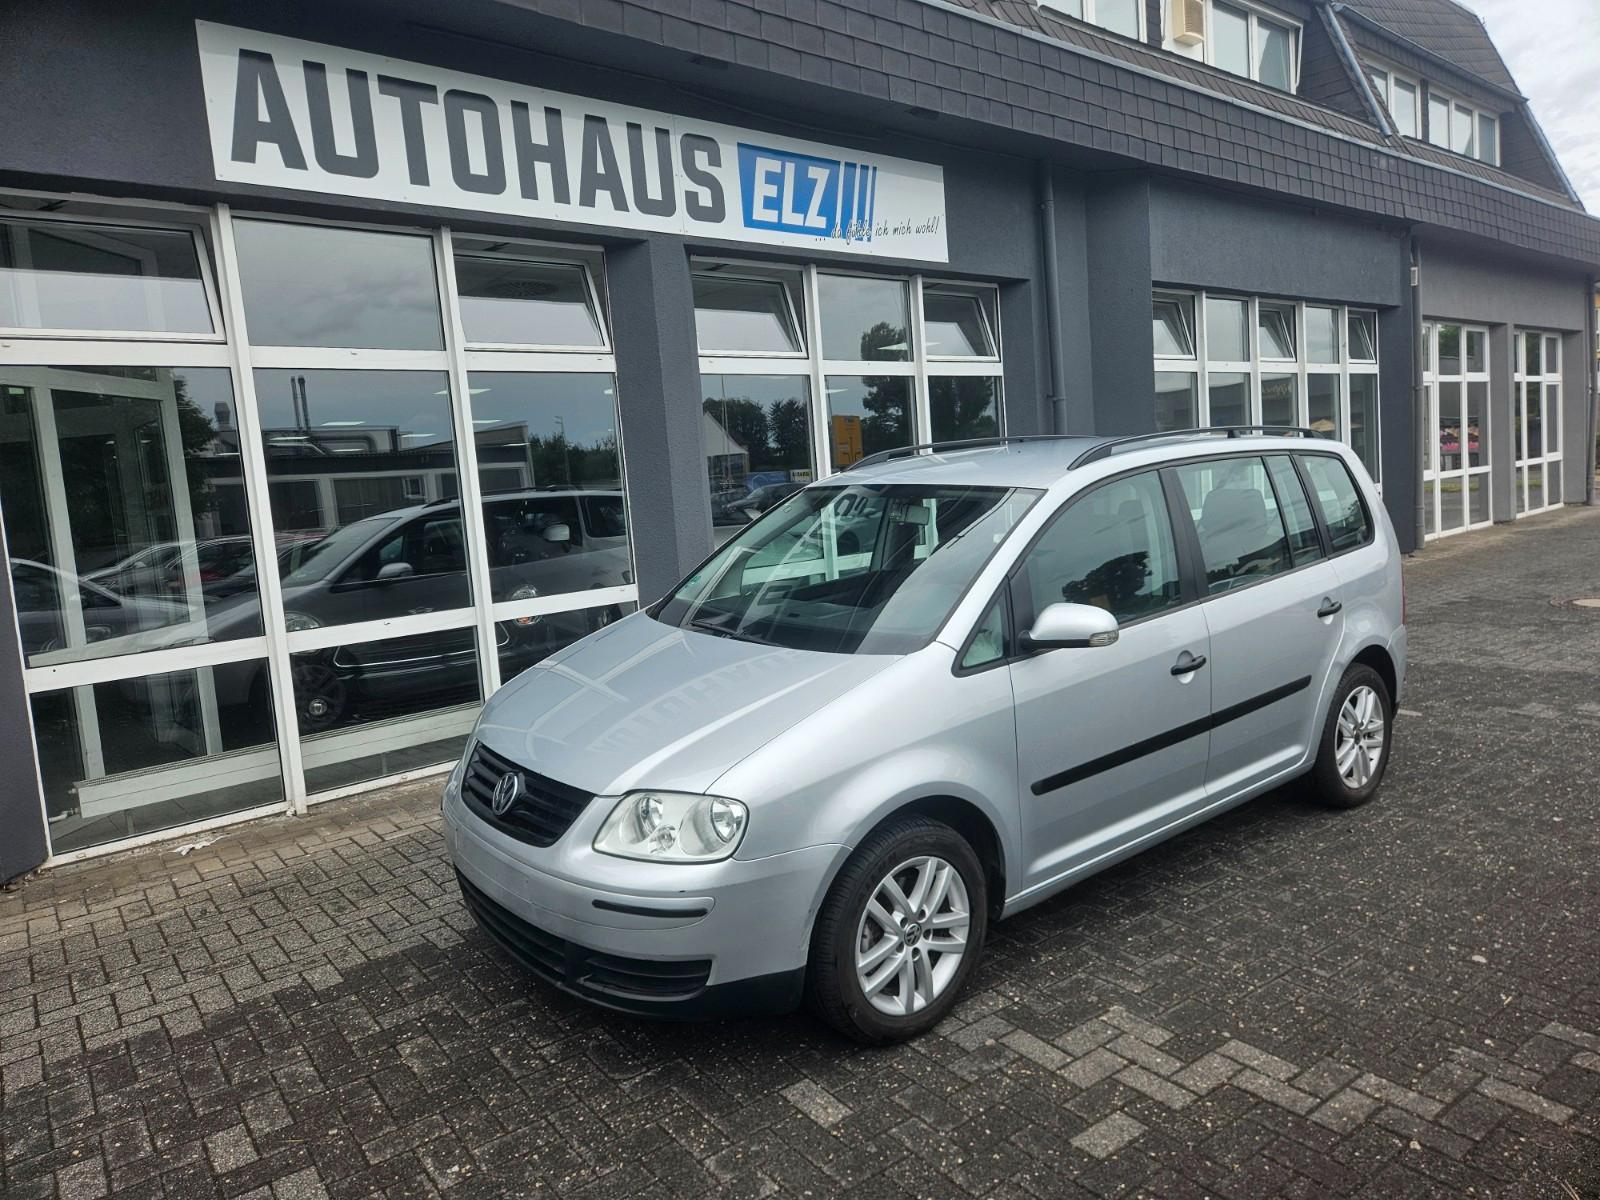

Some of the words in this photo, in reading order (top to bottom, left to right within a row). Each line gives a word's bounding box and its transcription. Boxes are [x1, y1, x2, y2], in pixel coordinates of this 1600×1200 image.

[231, 48, 726, 224] AUTOHAUS
[752, 156, 831, 229] ELZ
[875, 219, 889, 237] ich
[892, 218, 912, 237] mich
[915, 215, 941, 235] wohl!
